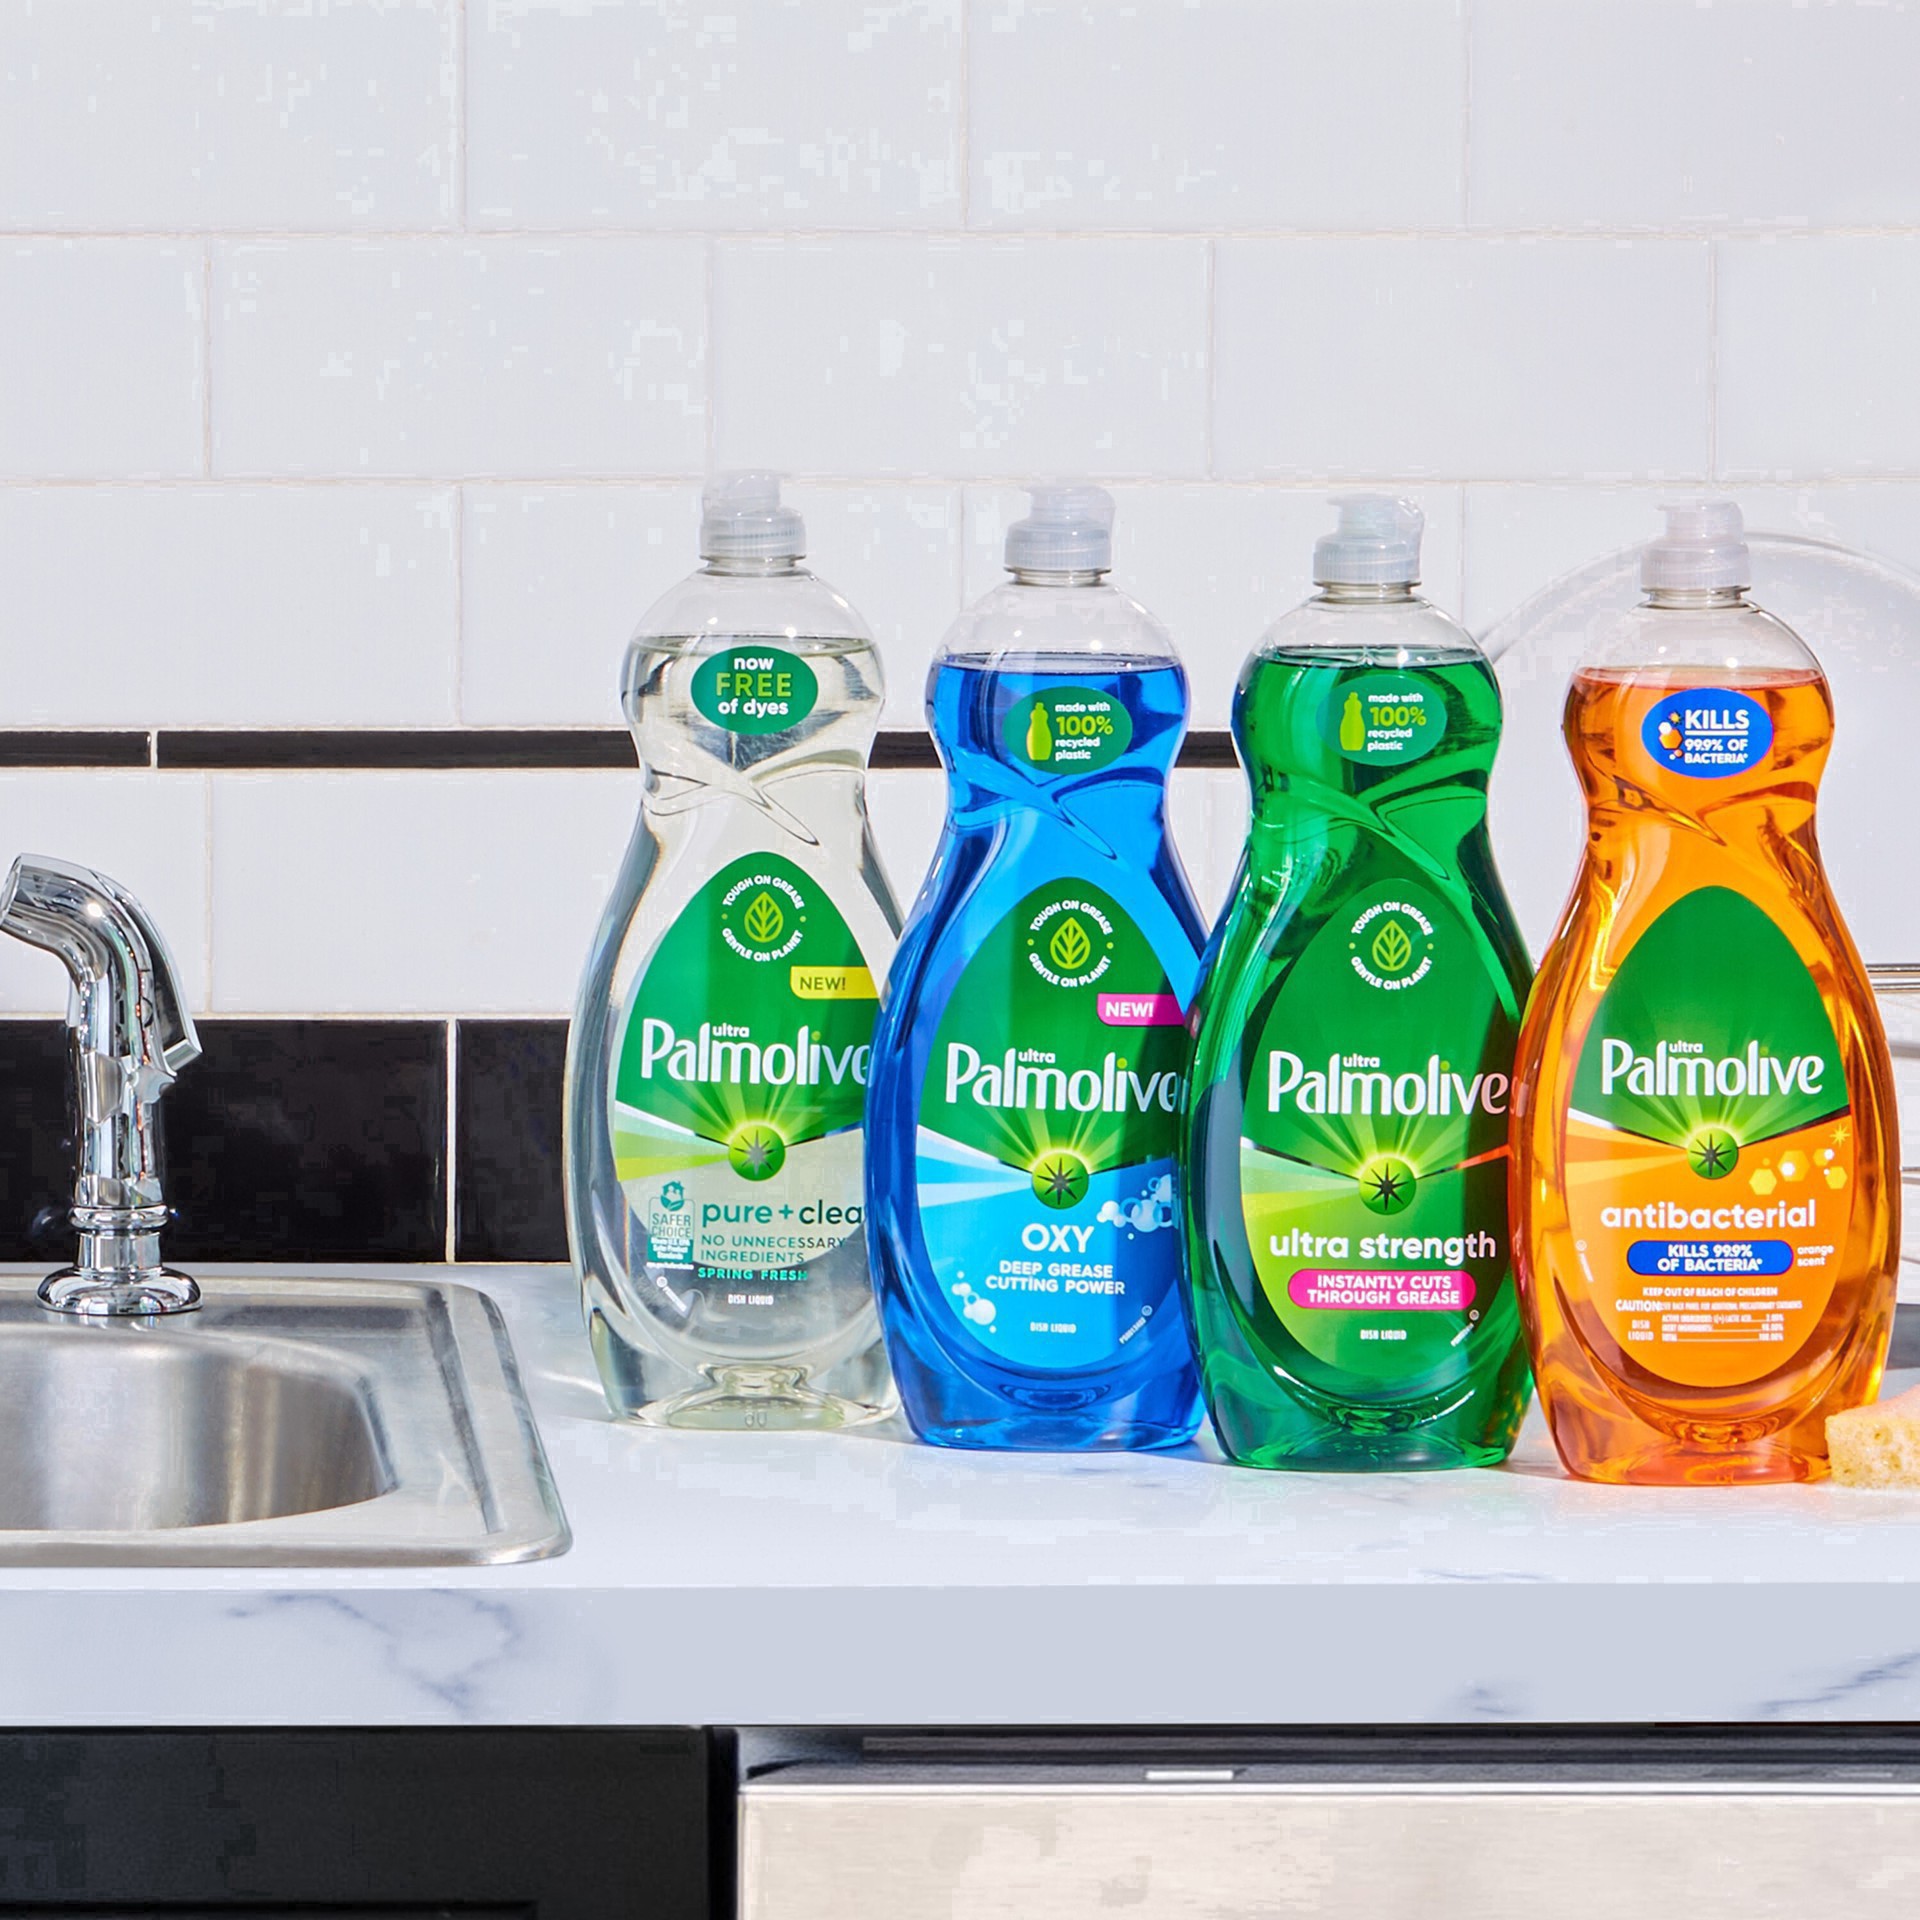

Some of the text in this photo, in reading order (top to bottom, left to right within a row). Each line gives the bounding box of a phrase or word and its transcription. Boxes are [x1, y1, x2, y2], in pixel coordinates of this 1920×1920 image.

[734, 658, 774, 670] now
[716, 673, 792, 697] FREE
[1368, 692, 1424, 703] made with
[718, 698, 789, 719] of dyes
[1055, 701, 1111, 712] made with
[1370, 706, 1427, 727] 100%
[1685, 709, 1750, 729] KILLS
[1056, 715, 1114, 736] 100%
[1367, 727, 1413, 740] recycled
[1055, 736, 1101, 749] recycled
[1367, 740, 1404, 752] plastic
[1727, 738, 1749, 752] OF
[1055, 749, 1092, 762] plastic
[722, 874, 805, 910] TOUGH ON GREASE
[1029, 899, 1113, 935] TOUGH ON GREASE
[1351, 901, 1434, 936] TOUGH ON GREASE
[722, 928, 803, 962] GENTLE ON PLANET
[1029, 952, 1112, 987] GENTLE ON PLANET
[1351, 956, 1433, 990] GENTLE ON PLANET
[800, 976, 846, 991] NEW!
[1105, 1001, 1154, 1018] NEW!
[712, 1022, 750, 1038] ultra
[1668, 1039, 1703, 1054] ultra
[1018, 1048, 1056, 1064] ultra
[1343, 1053, 1380, 1068] ultra
[1602, 1038, 1825, 1096] Palmolive
[1268, 1050, 1509, 1115] Palmolive
[652, 1212, 692, 1227] SAFER
[702, 1199, 863, 1229] pure + clea
[1600, 1199, 1816, 1230] antibacterial
[651, 1225, 691, 1238] CHOICE
[1021, 1223, 1095, 1253] OXY
[701, 1235, 725, 1247] NO
[732, 1235, 847, 1249] UNNECESSARY
[1269, 1227, 1497, 1267] ultra strength
[701, 1250, 805, 1264] INGREDIENTS
[1668, 1244, 1710, 1258] KILLS
[1797, 1245, 1835, 1256] orange
[999, 1260, 1113, 1279] DEEP GREASE
[1657, 1258, 1680, 1272] OF
[1797, 1257, 1826, 1267] scent
[698, 1267, 808, 1281] SPRING FRESH
[1317, 1274, 1452, 1290] INSTANTLY CUTS
[985, 1274, 1126, 1295] CUTTING POWER
[1642, 1286, 1779, 1297] KEEP OUT OF REACH OF CHILDREN
[727, 1293, 775, 1306] DISH LIQUID
[1307, 1289, 1460, 1305] THROUGH GREASE
